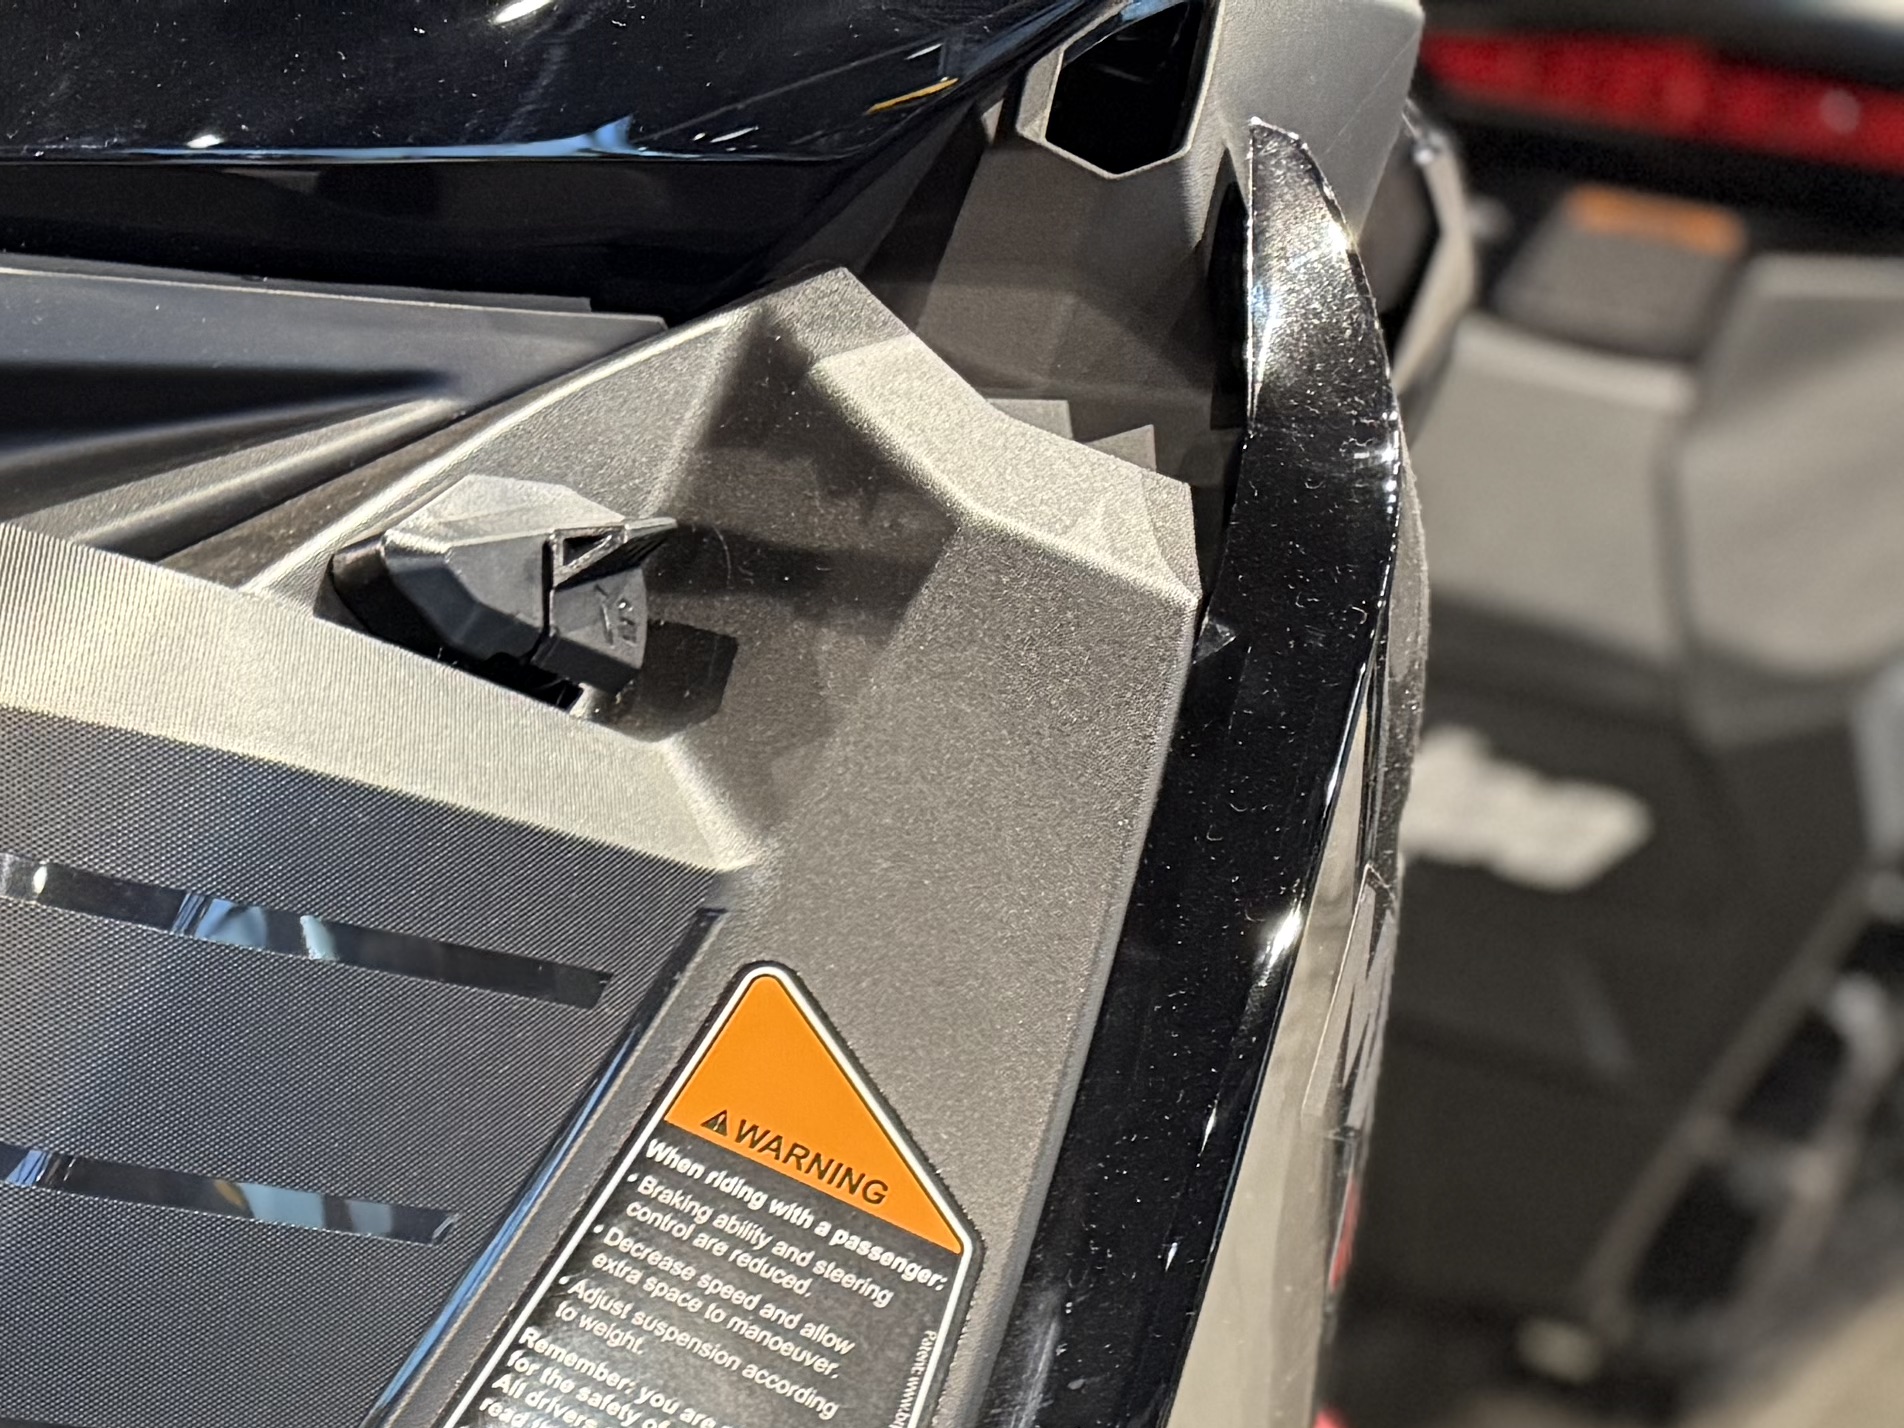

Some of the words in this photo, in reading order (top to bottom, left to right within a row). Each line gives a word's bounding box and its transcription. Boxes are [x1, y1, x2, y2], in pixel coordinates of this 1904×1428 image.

[644, 1137, 706, 1179] When
[702, 1169, 769, 1211] riding
[767, 1197, 815, 1229] with
[812, 1219, 833, 1237] a
[827, 1228, 948, 1291] passenger:
[733, 1117, 889, 1205] WARNING
[602, 1225, 697, 1281] Decrease
[695, 1272, 762, 1311] speed
[757, 1302, 803, 1330] and
[798, 1321, 856, 1355] allow
[625, 1200, 697, 1241] control
[690, 1231, 729, 1257] are
[727, 1247, 813, 1298] reduced.
[636, 1173, 715, 1225] Braking
[710, 1212, 772, 1251] ability
[770, 1239, 816, 1267] and
[811, 1258, 895, 1309] steering
[517, 1326, 640, 1395] Remember:
[632, 1385, 681, 1415] you
[554, 1299, 578, 1322] to
[577, 1313, 647, 1356] weight.
[566, 1277, 635, 1320] Adjust
[629, 1309, 743, 1371] suspension
[740, 1362, 840, 1420] according
[590, 1251, 644, 1285] extra
[641, 1275, 704, 1313] space
[702, 1301, 727, 1323] to
[724, 1314, 840, 1379] manoeuver.
